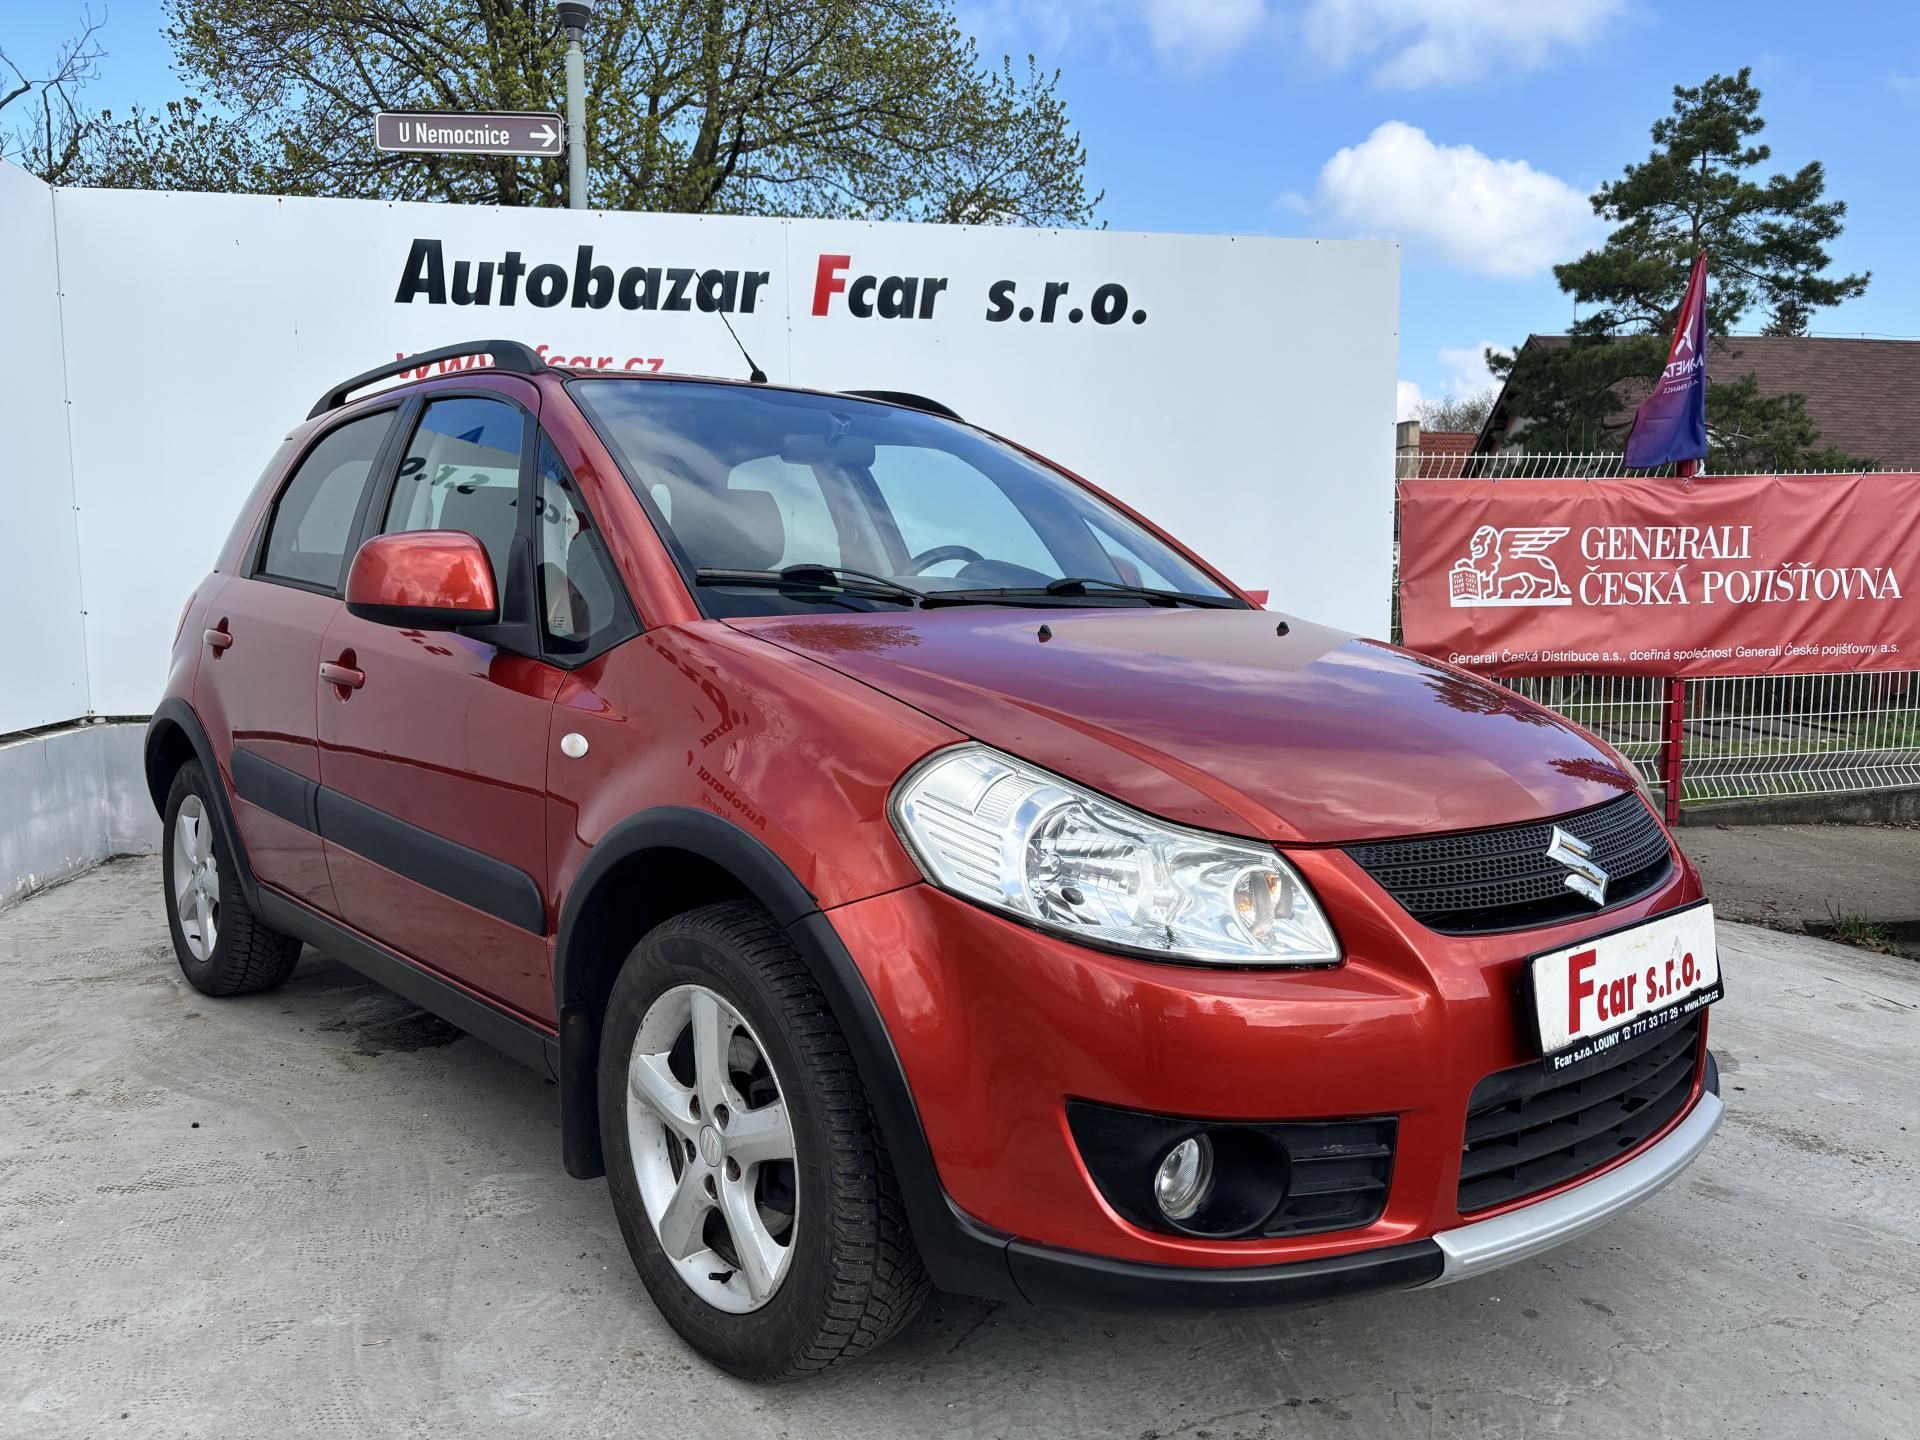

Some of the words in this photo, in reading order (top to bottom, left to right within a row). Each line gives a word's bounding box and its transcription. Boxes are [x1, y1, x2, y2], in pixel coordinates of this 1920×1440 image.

[399, 121, 411, 143] U
[416, 122, 510, 146] Nemocnice
[394, 238, 770, 314] Autobazar
[811, 254, 949, 320] Fcar
[985, 279, 1148, 325] s.r.o.
[1580, 524, 1753, 561] GENERALI
[1578, 564, 1690, 606] ČESKÁ
[1702, 561, 1903, 603] POJIŠŤOVNA
[1448, 652, 1498, 664] Generali
[1501, 649, 1538, 663] Česká
[1541, 650, 1600, 662] Distribuce
[1602, 652, 1626, 663] a.s.,
[1629, 648, 1671, 661] dceřiná
[1673, 648, 1732, 662] společnost
[1735, 645, 1782, 658] Generali
[1784, 642, 1819, 656] České
[1821, 642, 1877, 657] pojišťovny
[1880, 644, 1900, 654] a.s.
[1568, 948, 1637, 1036] Fcar
[1645, 952, 1701, 1004] s.r.o.
[1554, 1053, 1573, 1070] Fcar
[1593, 1031, 1620, 1053] LOUNY
[1632, 1019, 1647, 1035] 777
[1648, 1015, 1659, 1029] 33
[1659, 1010, 1668, 1024] 77
[1669, 1007, 1679, 1020] 29
